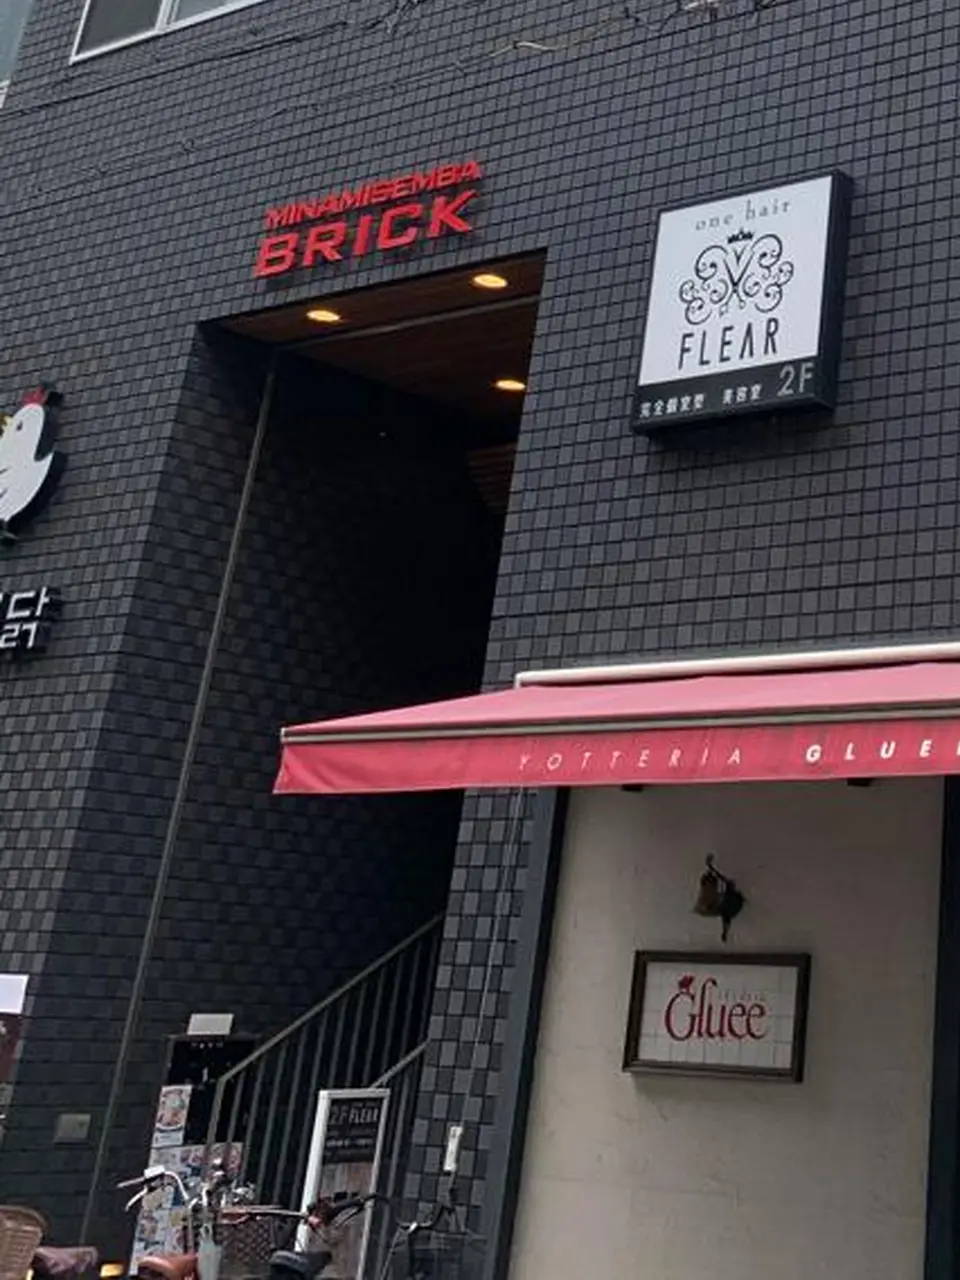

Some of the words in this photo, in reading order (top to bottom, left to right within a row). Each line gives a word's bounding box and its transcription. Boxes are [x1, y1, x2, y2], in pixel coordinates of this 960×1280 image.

[263, 159, 483, 228] MINAMISEMBA
[695, 212, 734, 231] one
[744, 197, 791, 222] hair
[252, 189, 480, 278] BRICK
[678, 317, 780, 370] FLEAR
[776, 362, 816, 397] 2F
[663, 976, 769, 1042] Gluee
